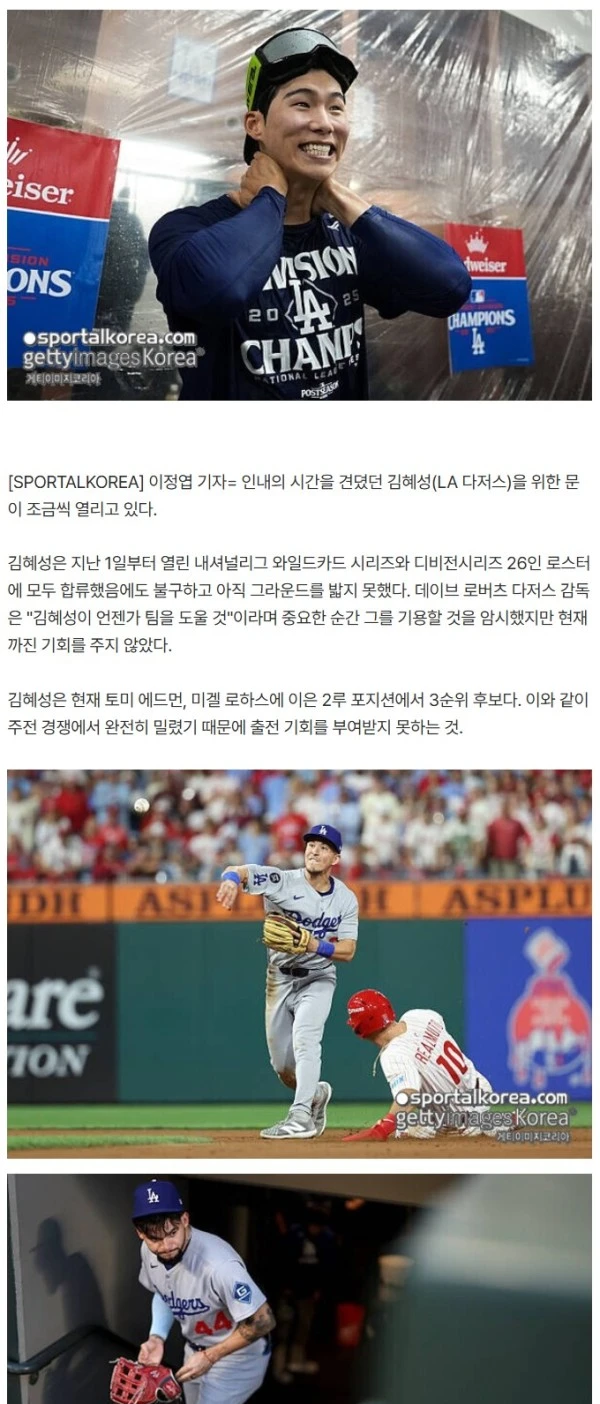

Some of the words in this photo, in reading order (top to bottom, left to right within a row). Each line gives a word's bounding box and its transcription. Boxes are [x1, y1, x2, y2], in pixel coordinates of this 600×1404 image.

[7, 254, 49, 266] SION
[463, 256, 507, 273] dweiser
[289, 279, 335, 335] LA
[472, 328, 485, 355] LA
[436, 1040, 468, 1085] 10
[147, 1188, 160, 1203] LA
[194, 1310, 233, 1336] 44
